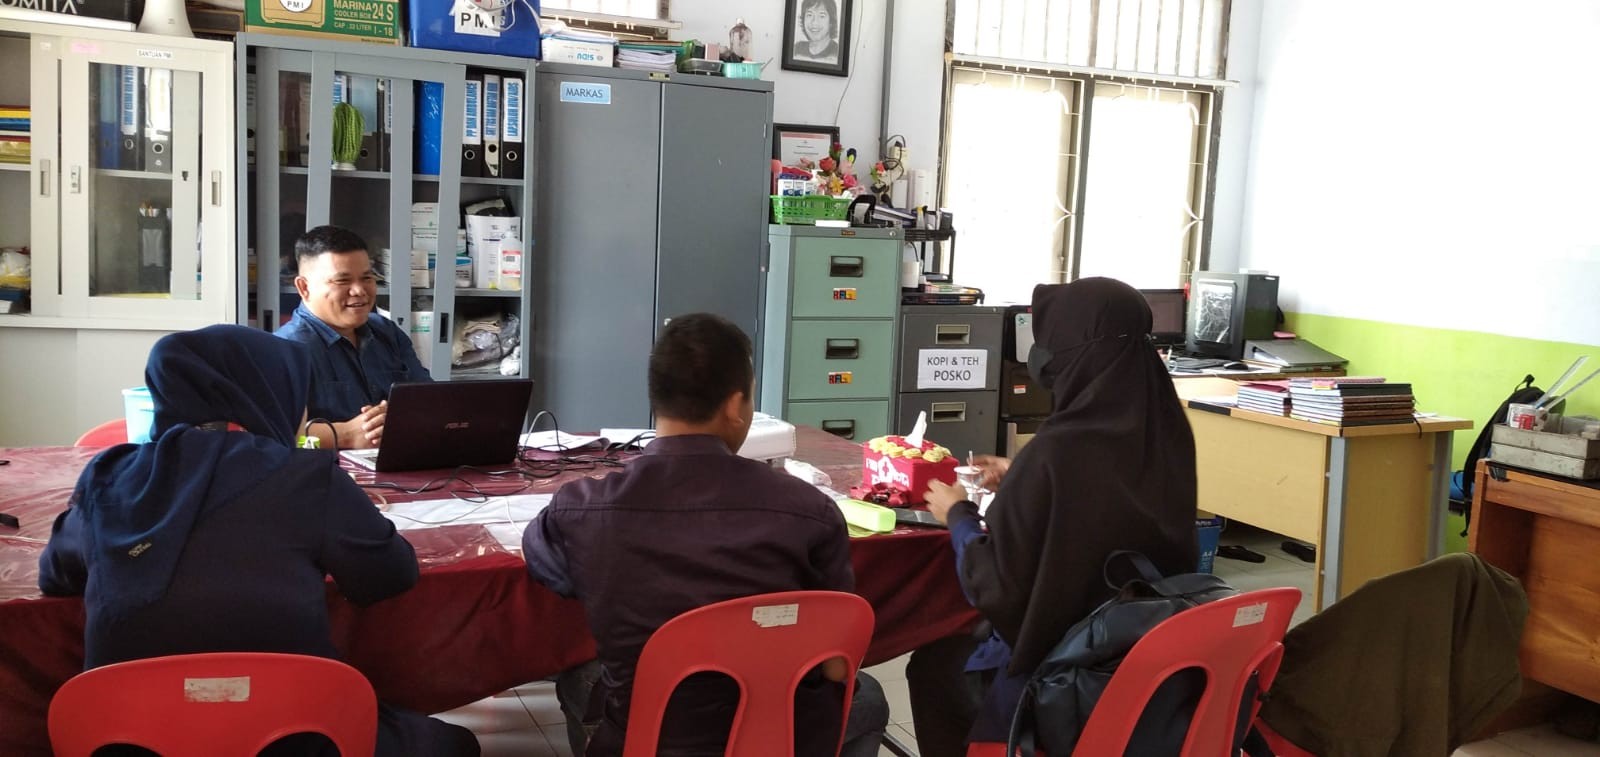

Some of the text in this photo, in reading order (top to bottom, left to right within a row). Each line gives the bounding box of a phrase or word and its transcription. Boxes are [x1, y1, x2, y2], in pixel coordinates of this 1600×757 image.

[334, 0, 394, 21] MARINA 24 S
[334, 9, 358, 17] COOLER
[565, 87, 604, 99] MARKAS
[927, 356, 979, 366] KOPI & TEH
[933, 370, 971, 381] POSKO
